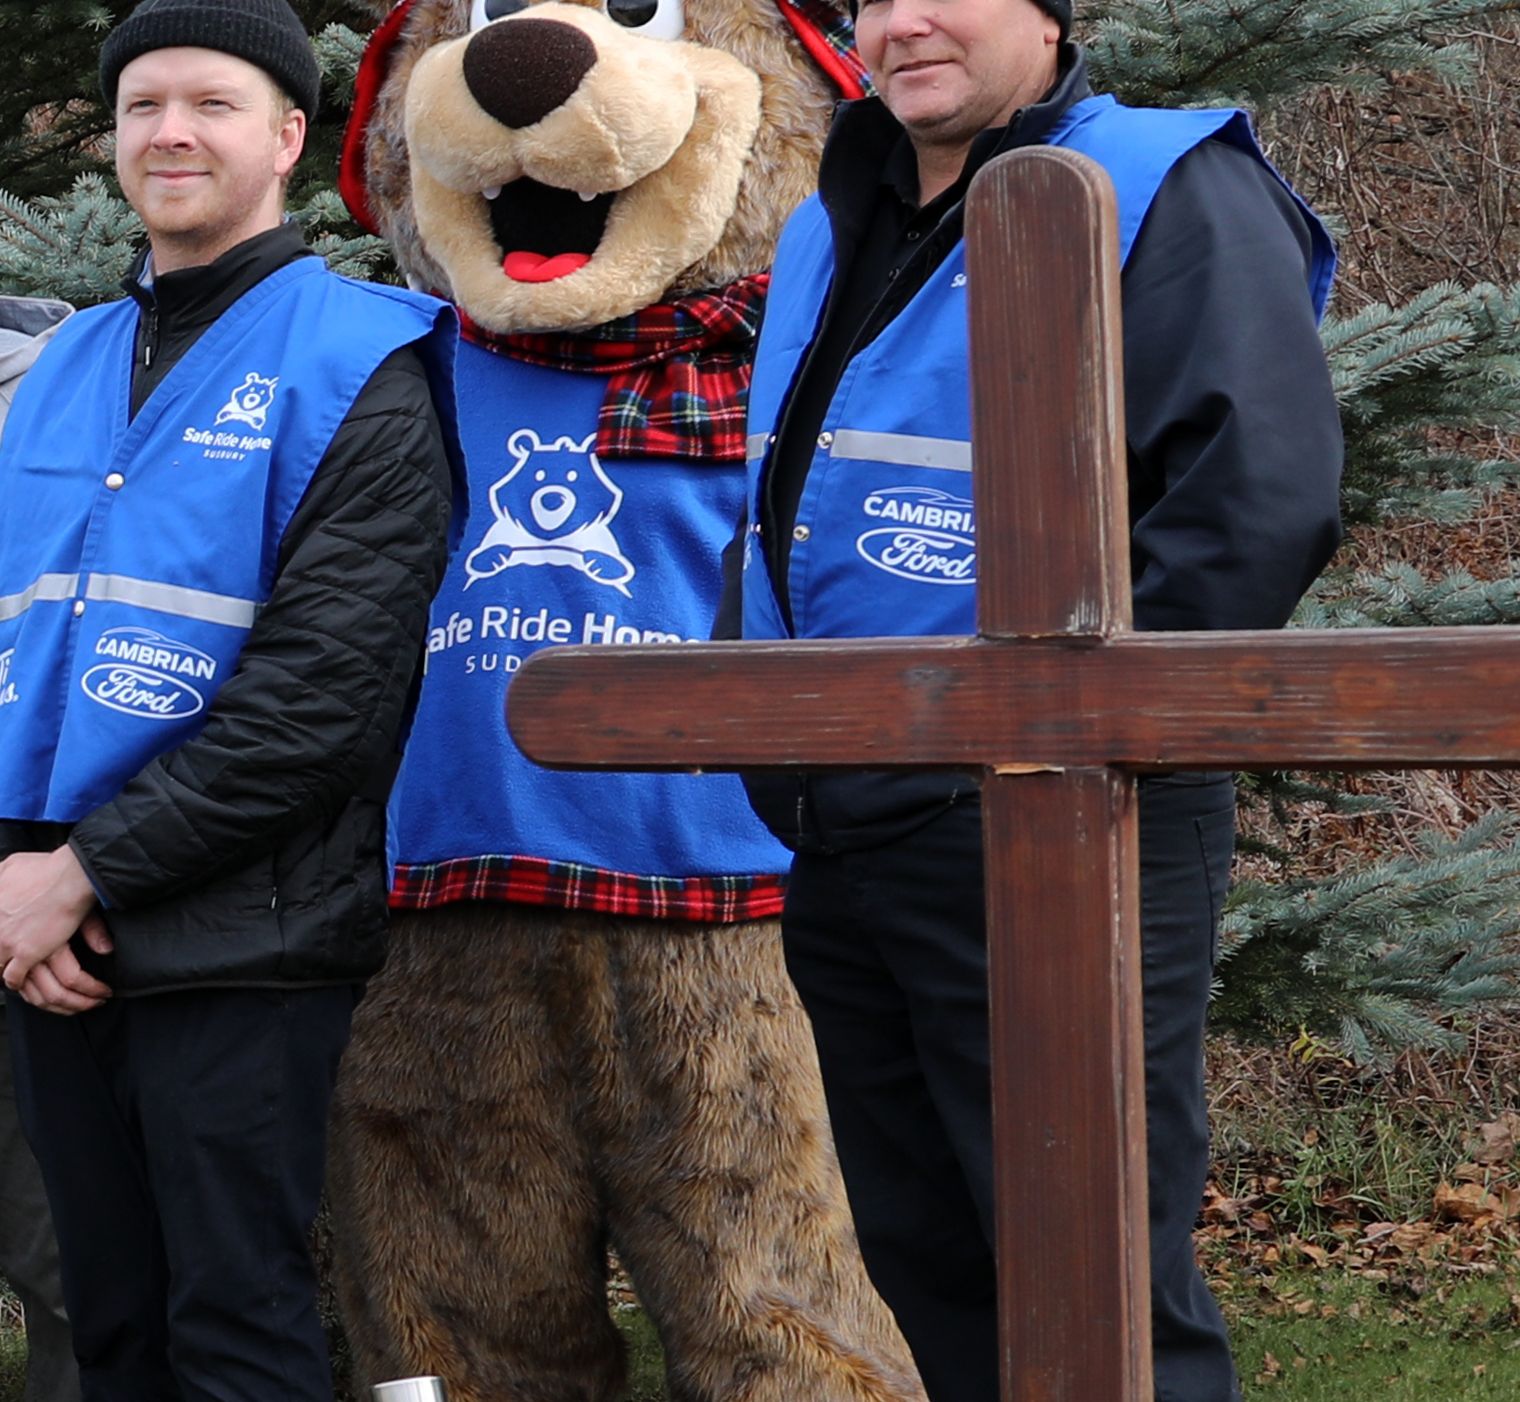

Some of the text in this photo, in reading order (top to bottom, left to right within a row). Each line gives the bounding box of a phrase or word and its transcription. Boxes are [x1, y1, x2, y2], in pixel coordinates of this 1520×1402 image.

[183, 427, 214, 446] Safe
[213, 431, 239, 448] Ride
[863, 495, 976, 533] CAMBRI
[880, 532, 976, 579] Ford
[424, 605, 701, 656] afe Ride Hom
[95, 637, 217, 680] CAMBRIAN
[97, 668, 181, 714] Ford
